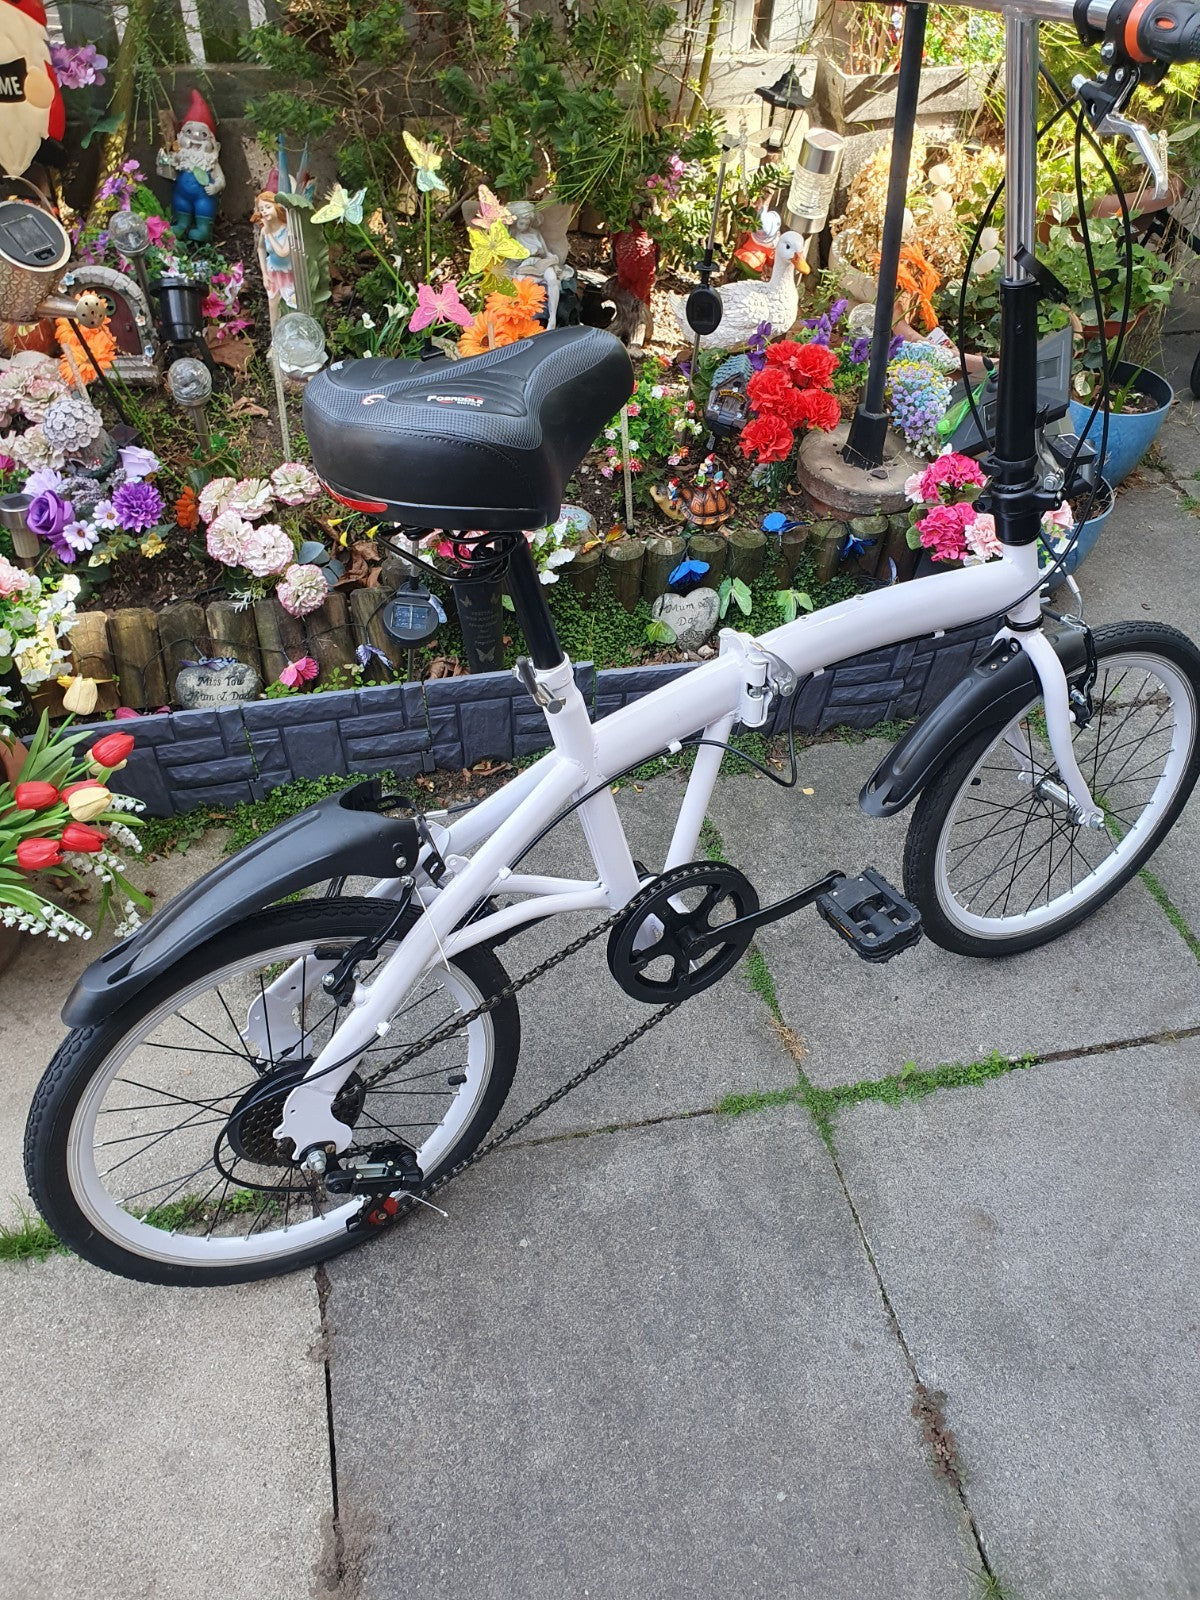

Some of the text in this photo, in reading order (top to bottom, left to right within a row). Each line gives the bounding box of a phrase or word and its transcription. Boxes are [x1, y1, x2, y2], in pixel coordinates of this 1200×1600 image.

[197, 675, 245, 687] Miss You
[231, 691, 253, 701] Dad
